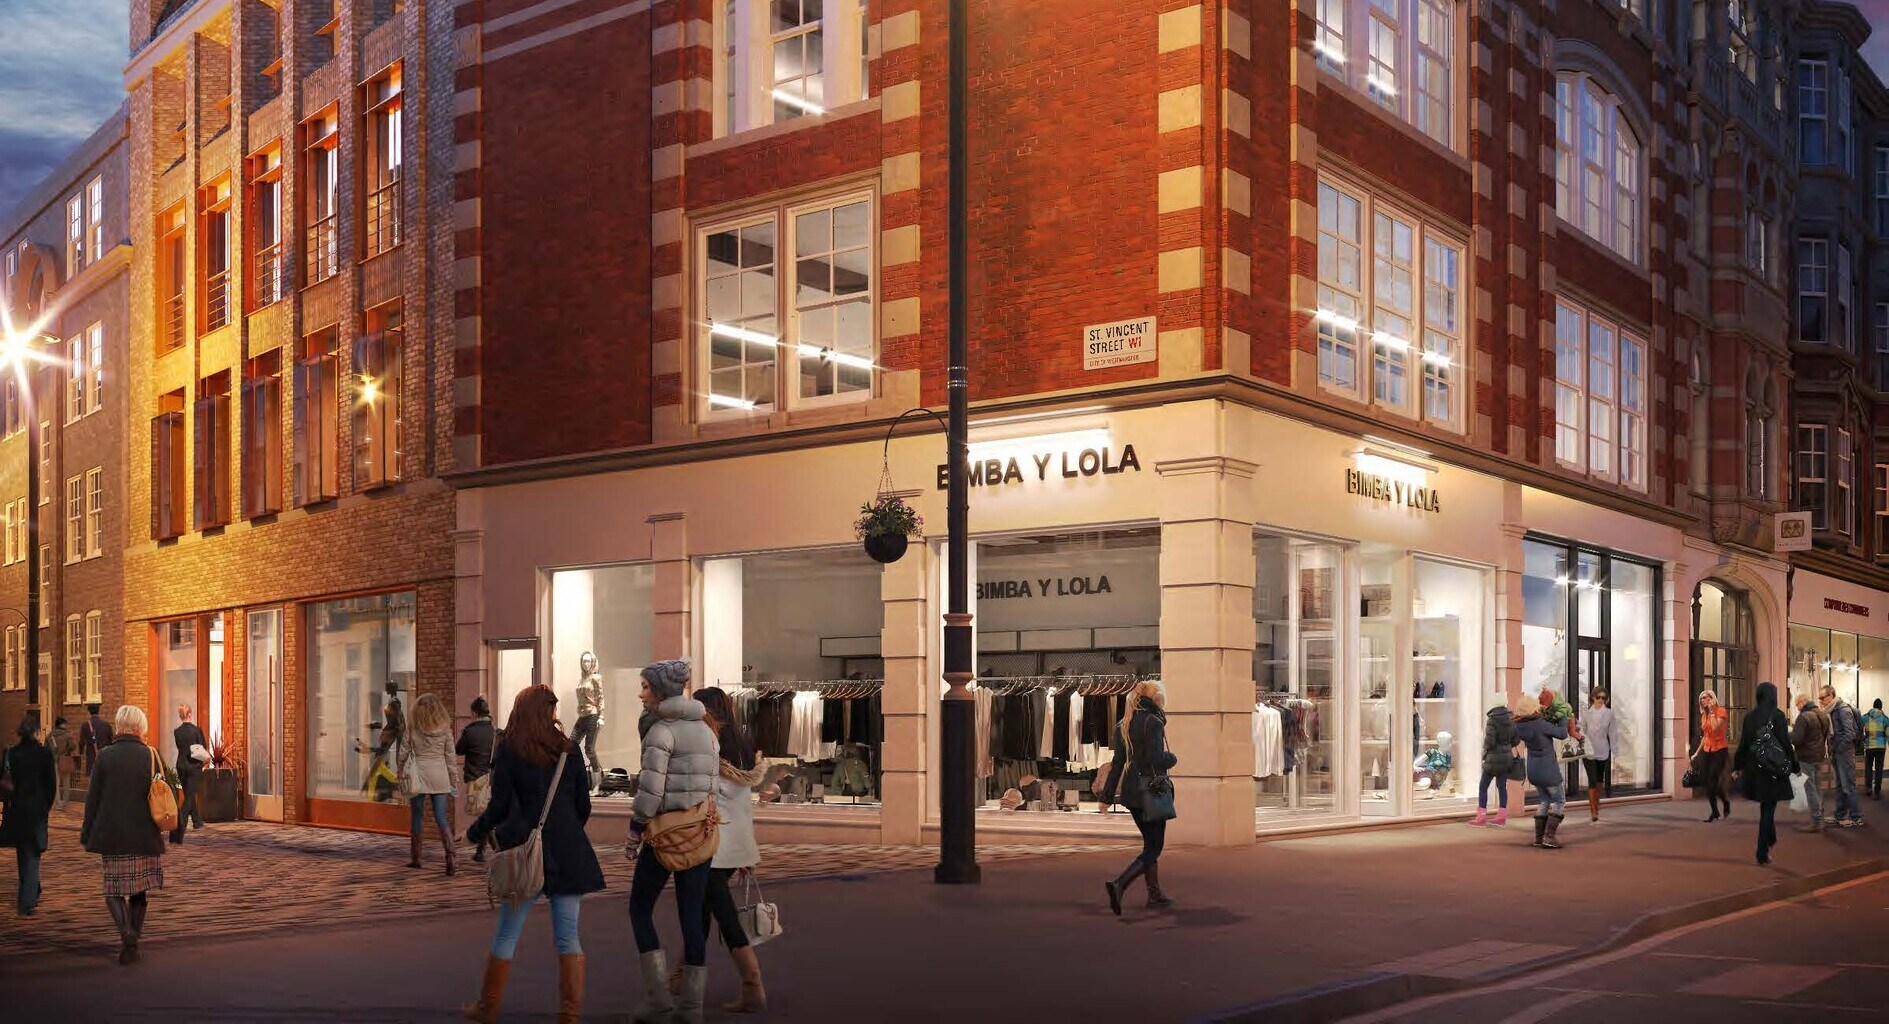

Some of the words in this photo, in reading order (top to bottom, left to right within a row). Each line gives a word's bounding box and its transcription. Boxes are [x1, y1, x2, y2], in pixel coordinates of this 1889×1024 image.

[1089, 329, 1103, 341] ST.
[1105, 321, 1149, 339] VINCENT
[1089, 339, 1125, 355] STREET
[1128, 336, 1142, 349] W1
[937, 456, 1024, 490] BMBA
[1032, 452, 1051, 481] Y
[1062, 444, 1141, 478] LOLA
[1345, 468, 1392, 501] BIMBA
[1394, 480, 1405, 504] Y
[1407, 482, 1440, 513] LOLA
[976, 580, 1032, 600] BIMBA
[1037, 578, 1051, 597] Y
[1057, 575, 1112, 596] LOLA
